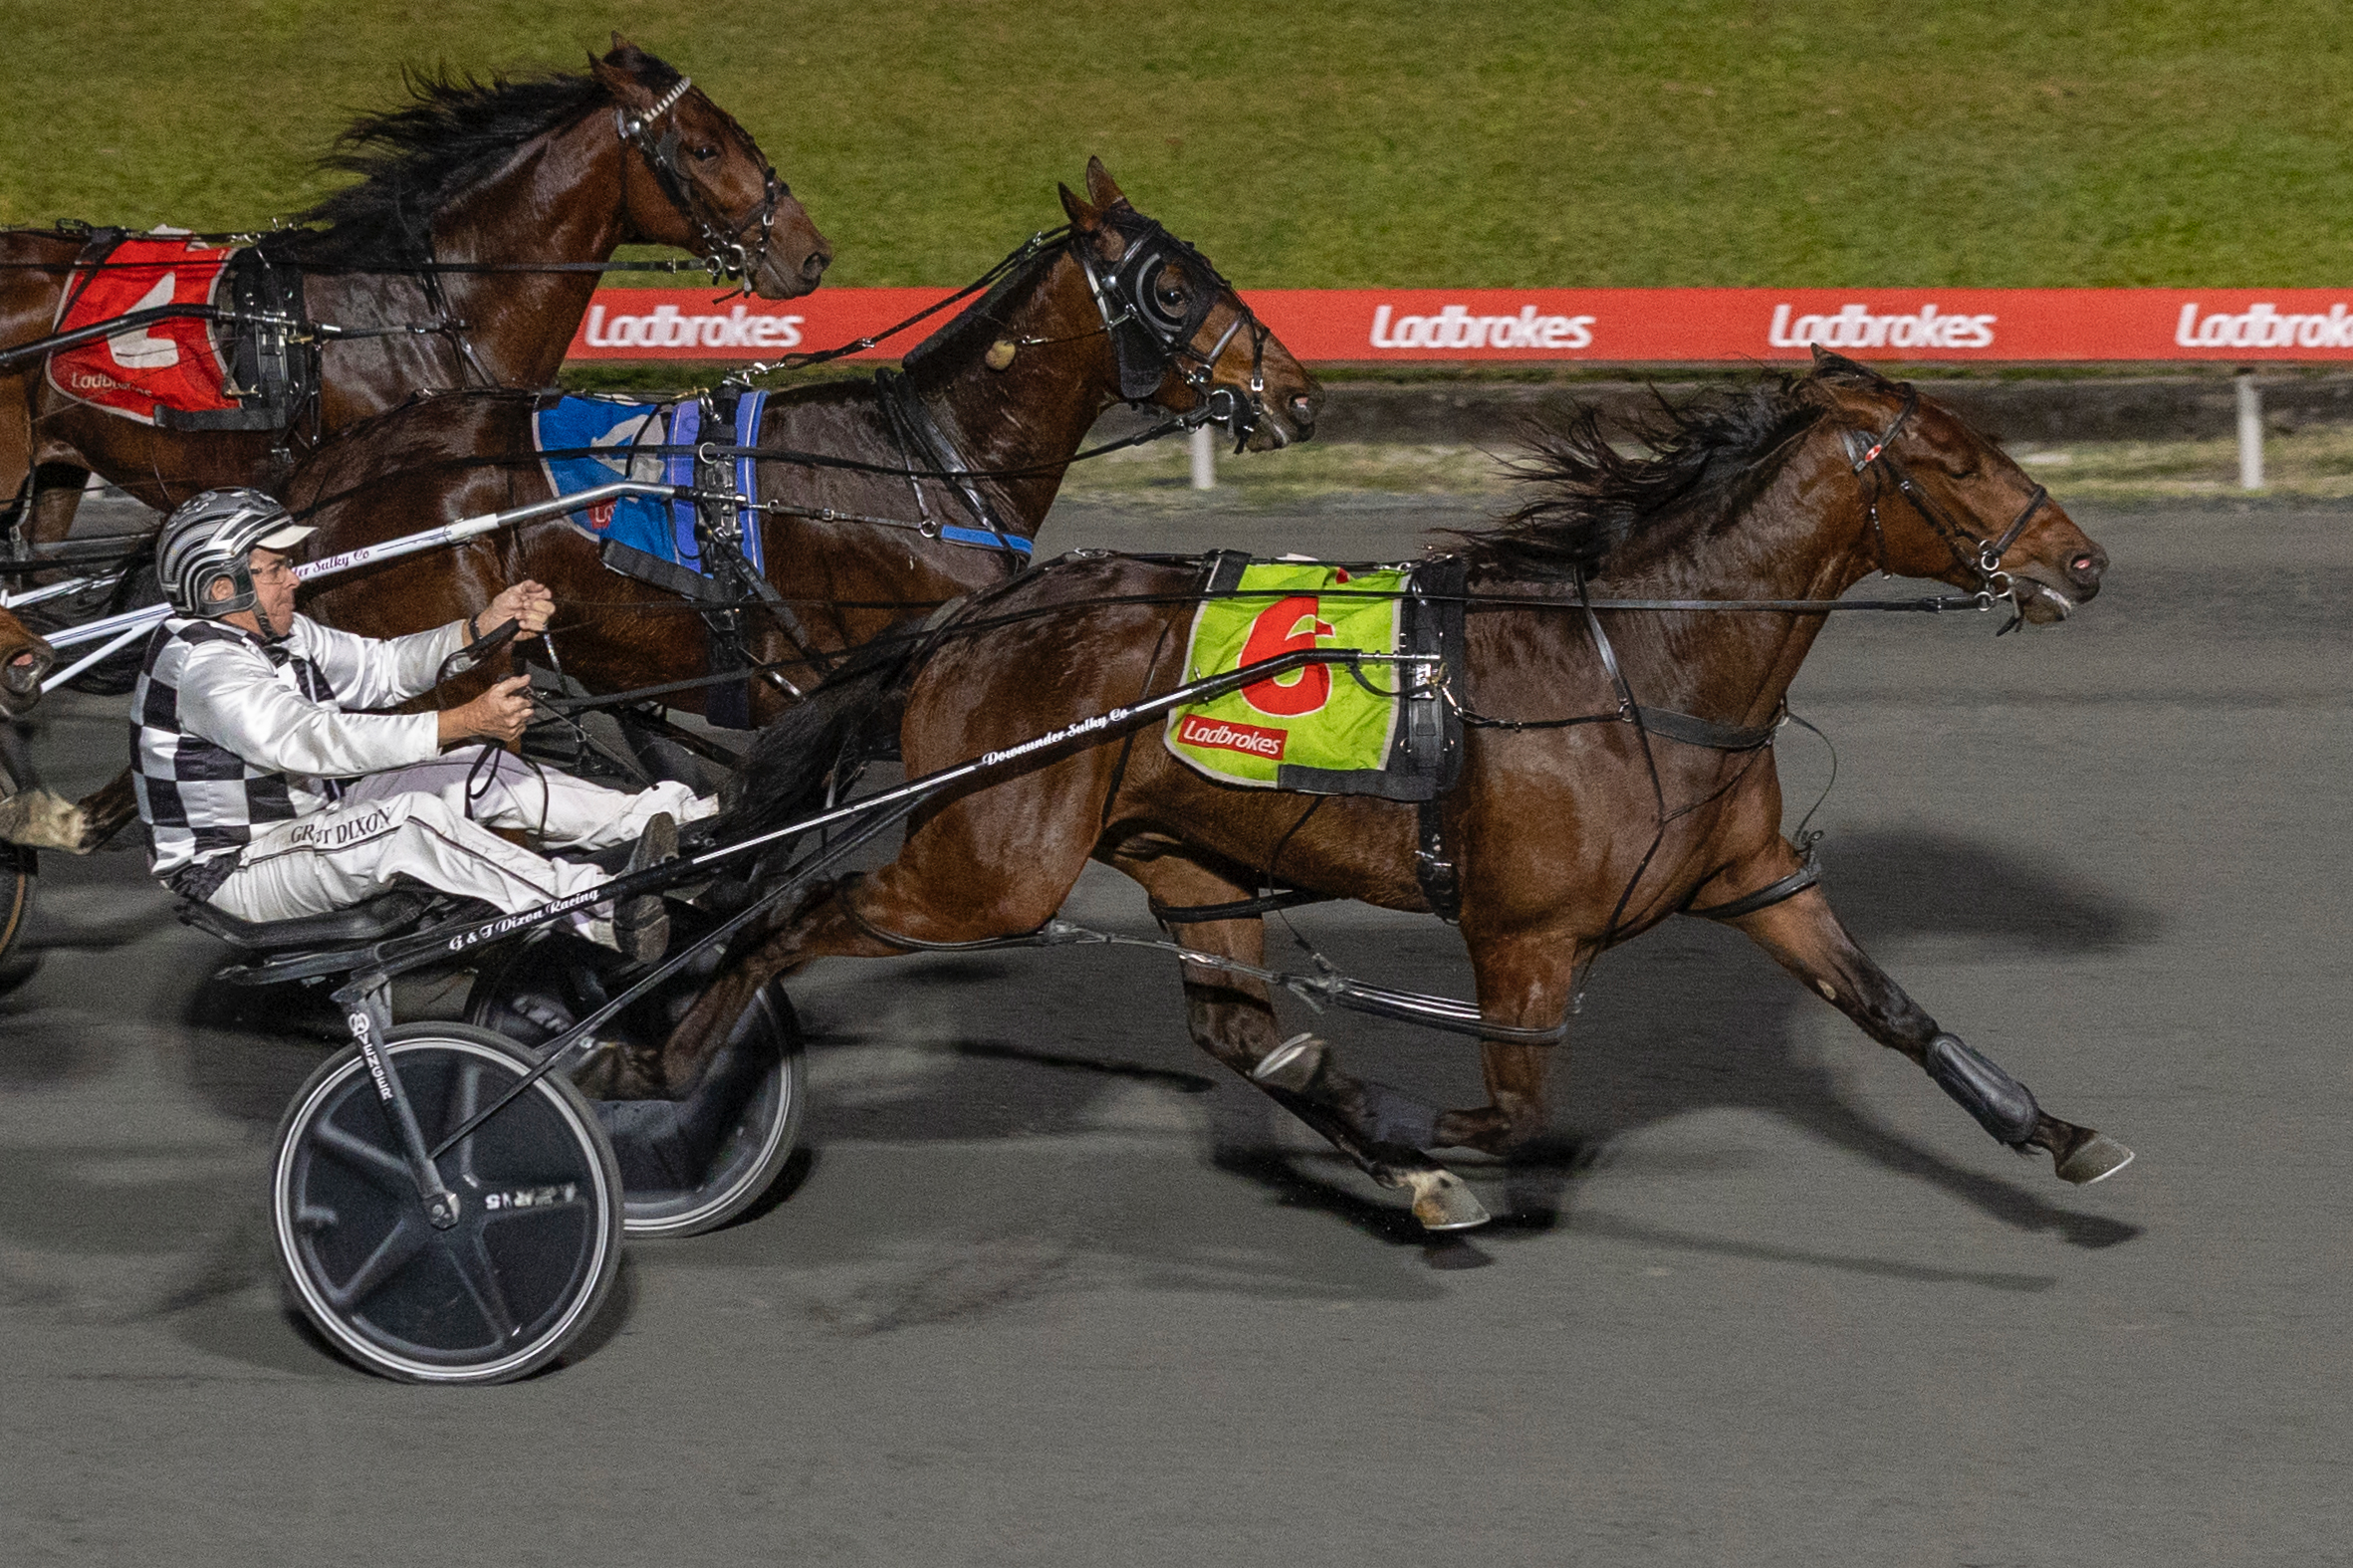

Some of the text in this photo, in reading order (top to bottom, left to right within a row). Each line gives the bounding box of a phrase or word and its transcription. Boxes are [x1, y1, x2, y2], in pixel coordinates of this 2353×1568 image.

[585, 305, 805, 347] Ladbrokes
[1369, 305, 1595, 348] Ladbrokes
[1767, 304, 1998, 348] Ladbrokes
[1237, 594, 1335, 719] 6
[982, 722, 1064, 766] Downunder
[1066, 717, 1107, 738] Sulky
[1183, 720, 1282, 755] Ladbrokes
[336, 806, 392, 844] DIXON
[466, 933, 478, 944] &
[495, 909, 546, 933] Dixon
[546, 889, 598, 914] Racing
